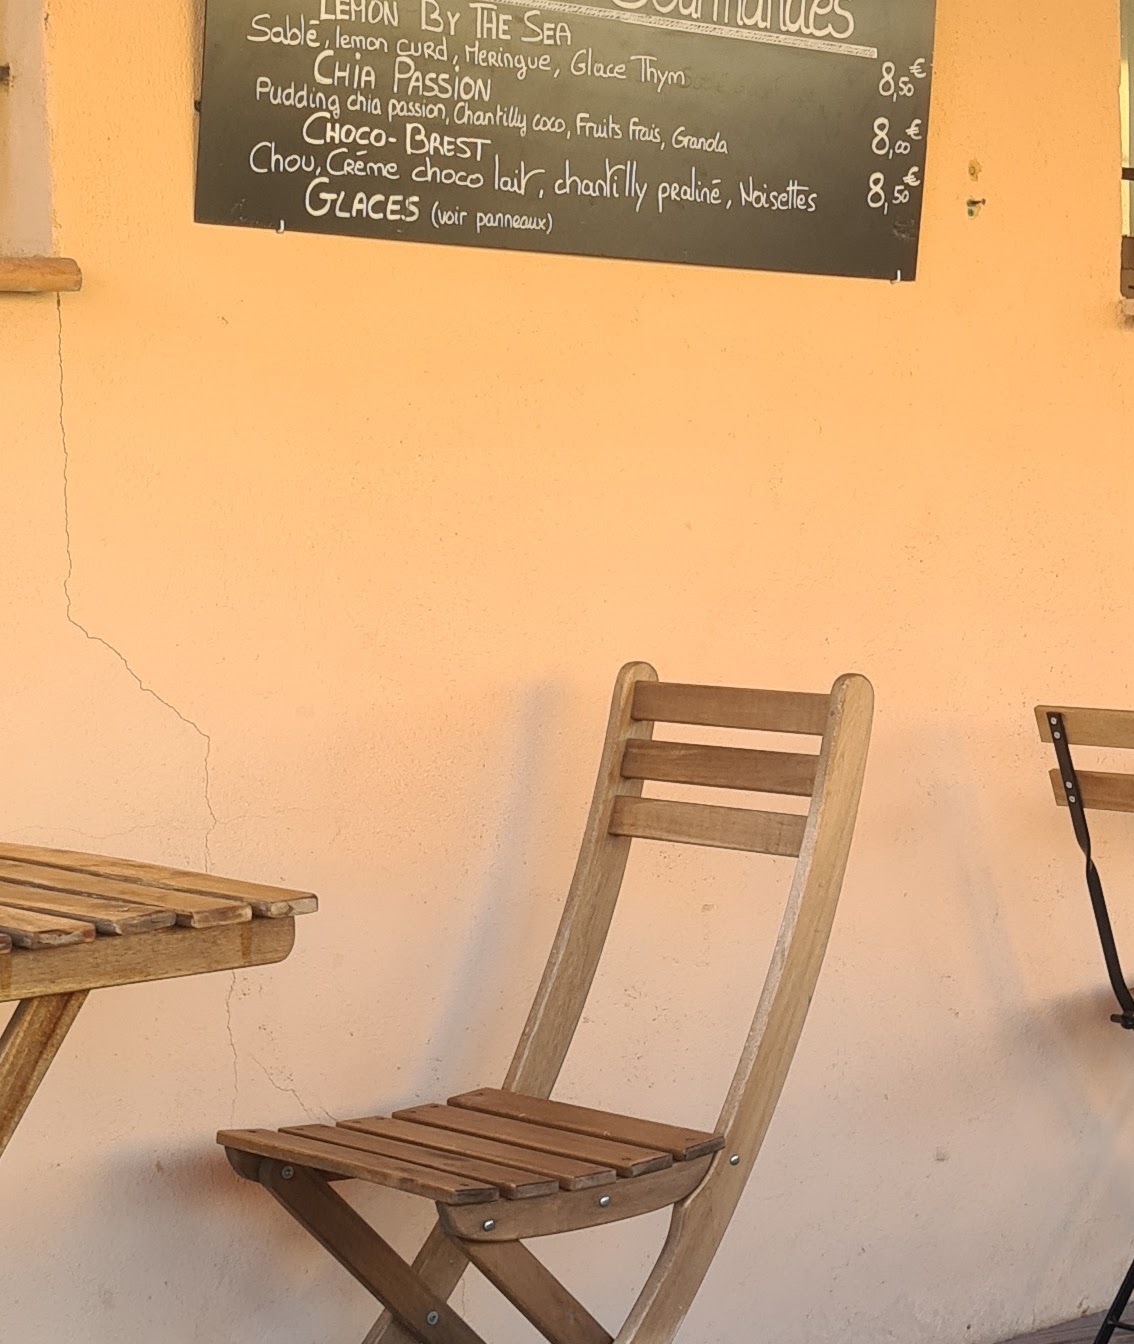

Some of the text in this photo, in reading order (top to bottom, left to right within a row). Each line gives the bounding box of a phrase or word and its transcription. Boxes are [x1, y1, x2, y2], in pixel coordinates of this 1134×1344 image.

[335, 24, 685, 93] lemon Glace Thym
[255, 75, 340, 120] Pudding
[346, 90, 382, 115] chia
[452, 96, 527, 137] Chantilly
[575, 111, 623, 139] Fruits
[411, 155, 818, 213] choco chantilly Noisettes
